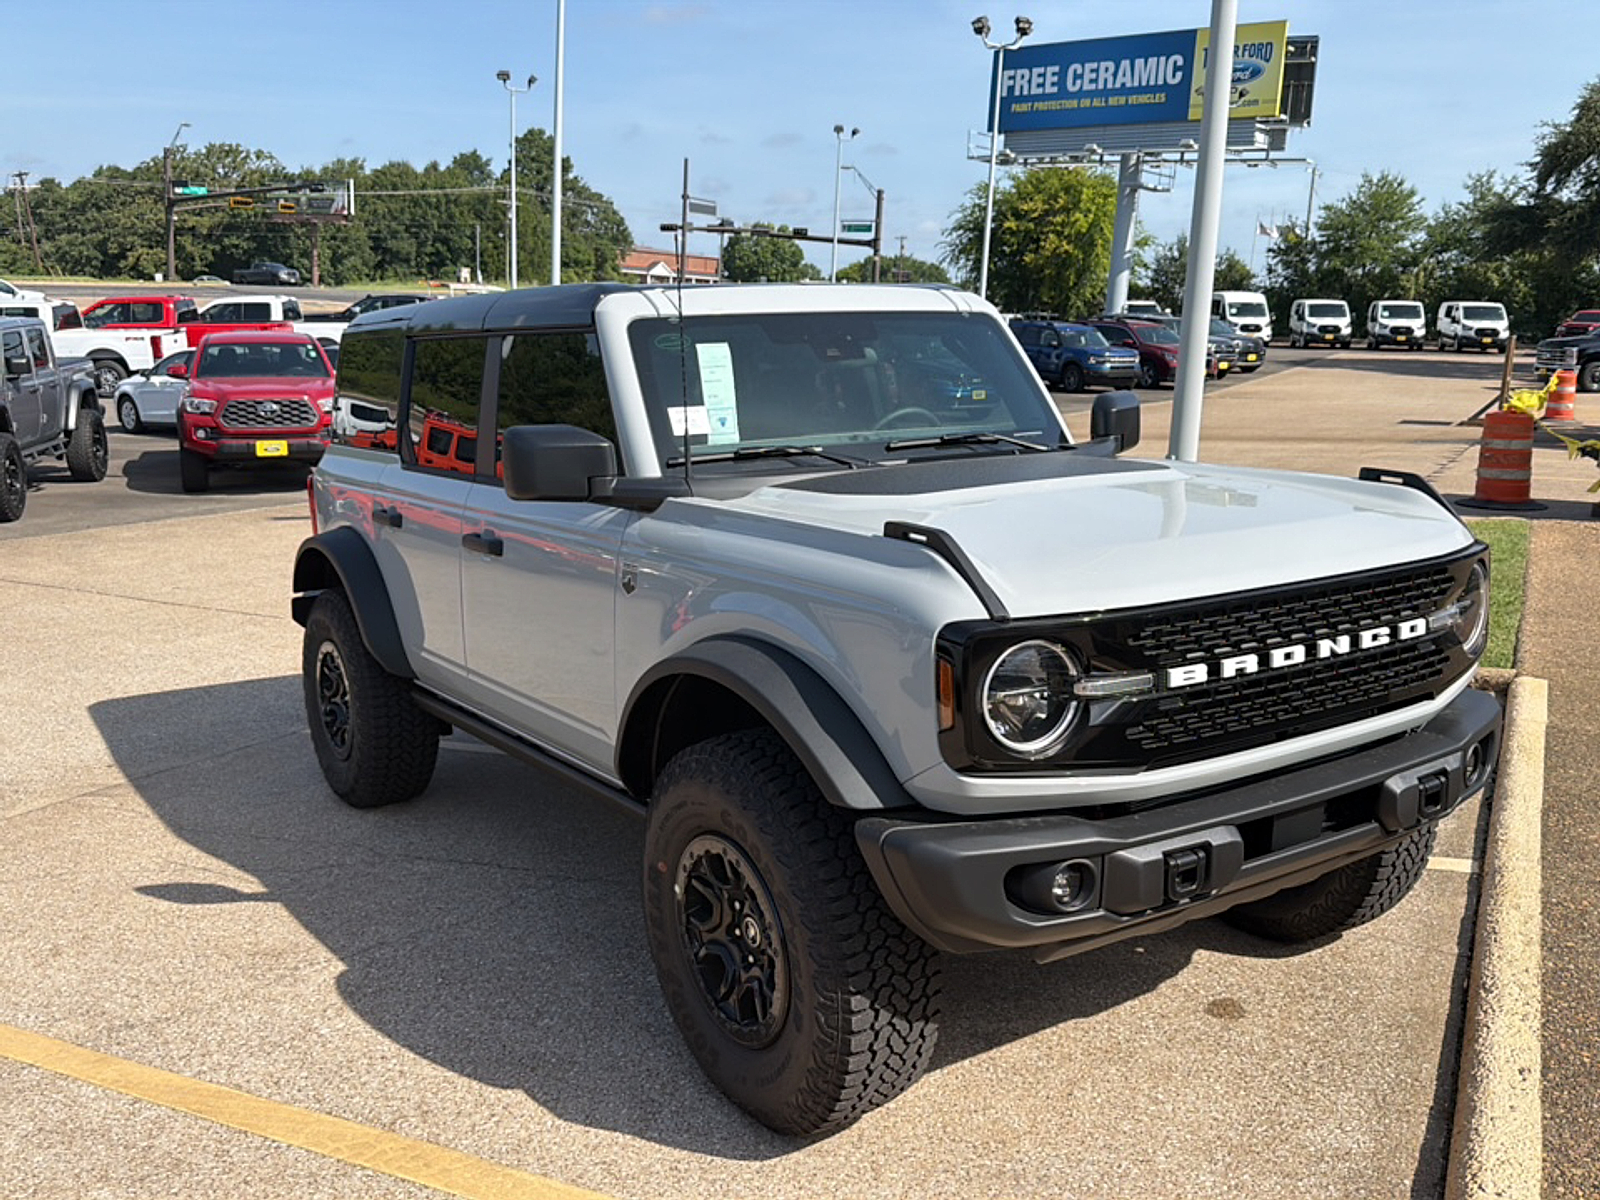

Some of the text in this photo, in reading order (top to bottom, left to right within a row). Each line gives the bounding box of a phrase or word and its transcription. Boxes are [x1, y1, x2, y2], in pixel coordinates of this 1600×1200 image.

[1242, 42, 1274, 64] FORD
[1001, 65, 1060, 97] FREE
[1066, 54, 1184, 93] CERAMIC
[1011, 93, 1167, 112] PAINT PROTECTION ON ALL NEW VEHICLES
[1167, 618, 1427, 689] BRONCO
